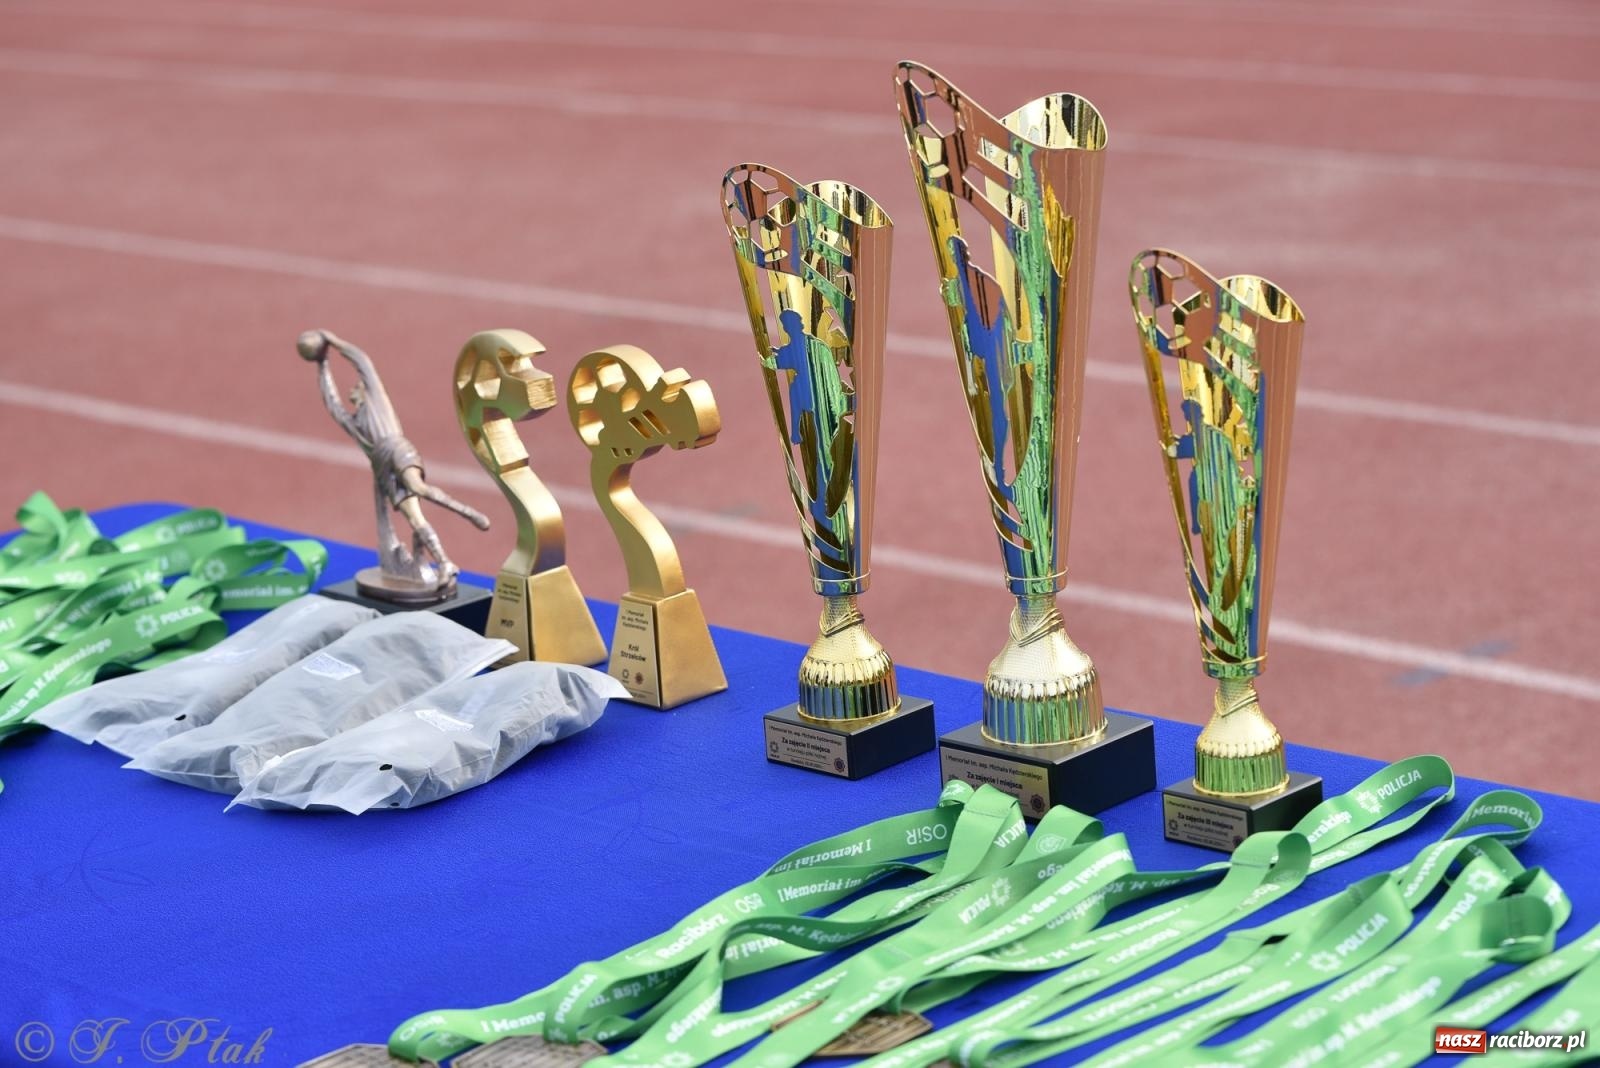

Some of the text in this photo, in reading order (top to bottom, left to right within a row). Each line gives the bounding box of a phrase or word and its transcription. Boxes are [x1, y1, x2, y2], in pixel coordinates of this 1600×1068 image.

[1000, 779, 1023, 790] miejsca
[1377, 769, 1422, 800] POLICJA
[906, 824, 948, 846] OSiR
[994, 819, 1026, 848] OLICJA
[793, 843, 863, 868] Memoriał
[785, 878, 844, 901] Memoriał
[1336, 912, 1389, 956] POLICJA
[554, 973, 598, 1024] POLICJA
[492, 1011, 546, 1033] Memo
